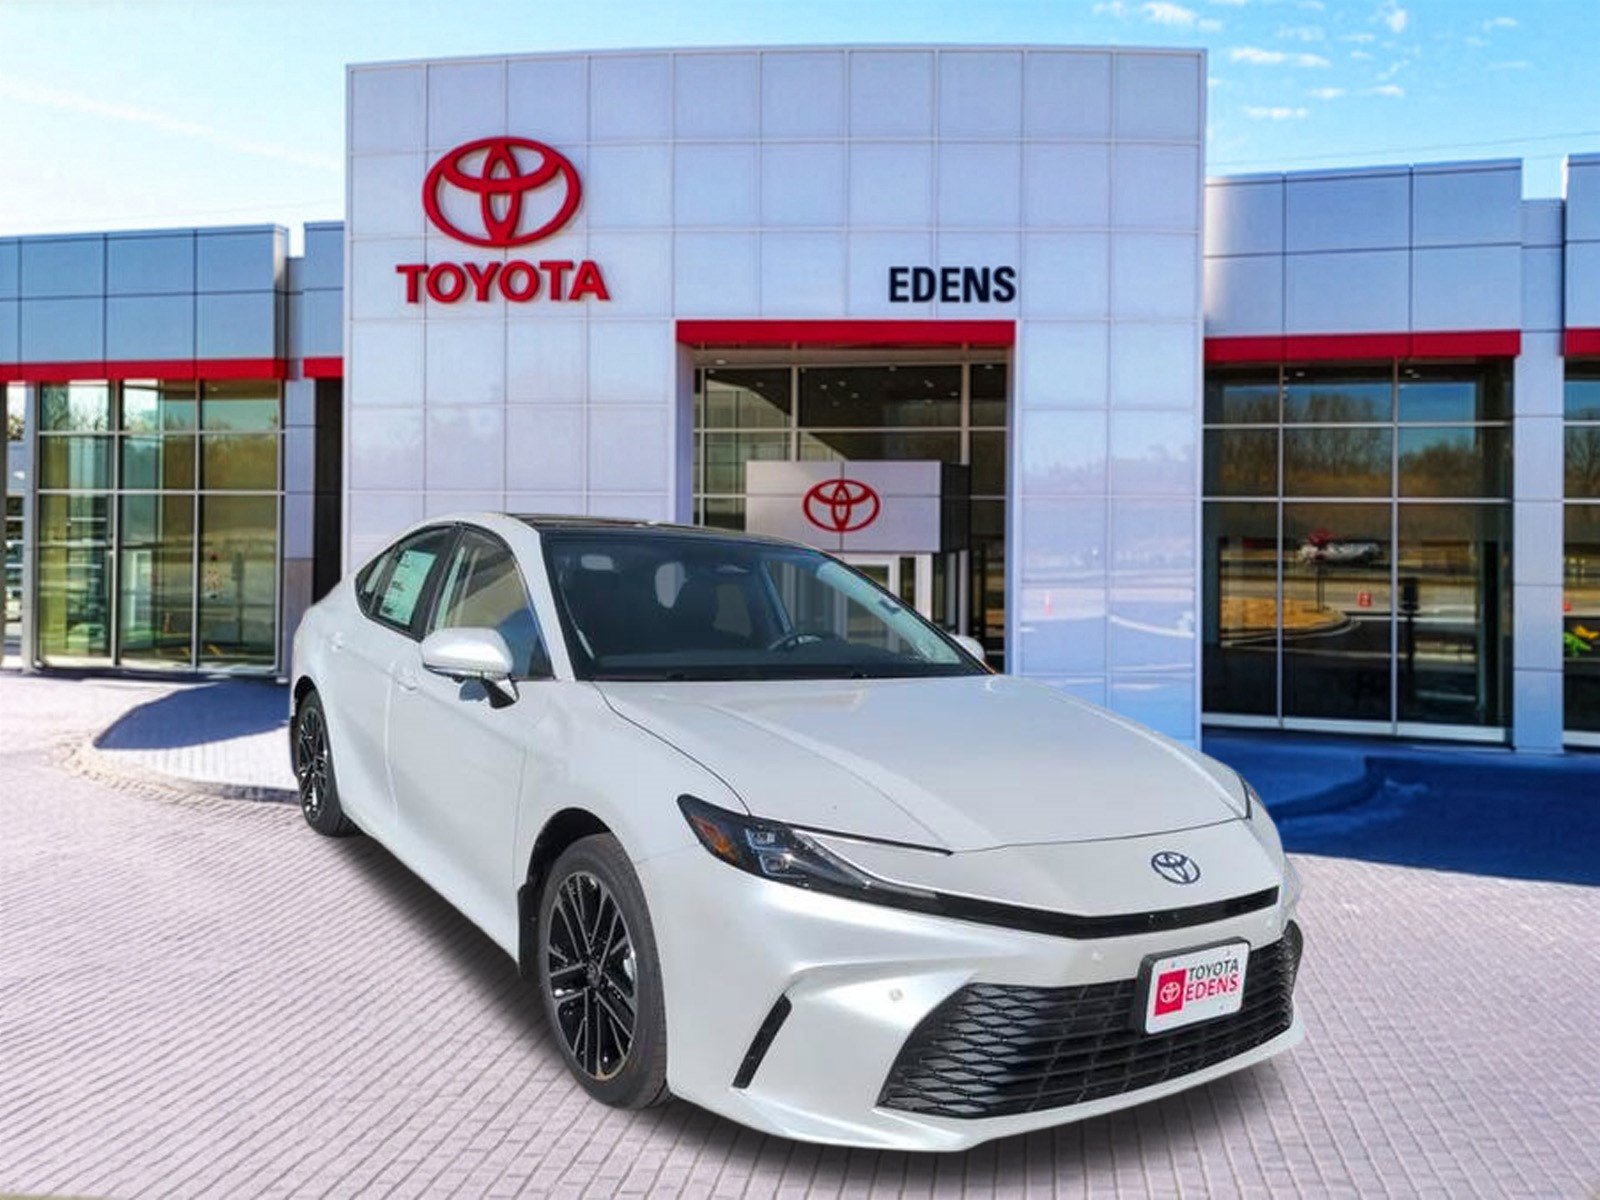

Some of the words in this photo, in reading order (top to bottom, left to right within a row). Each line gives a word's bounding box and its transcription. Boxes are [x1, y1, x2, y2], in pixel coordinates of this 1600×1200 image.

[396, 260, 609, 304] TOYOTA
[889, 266, 1016, 303] EDENS
[1188, 959, 1239, 981] TOYOTA
[1185, 974, 1239, 1001] EDENS
